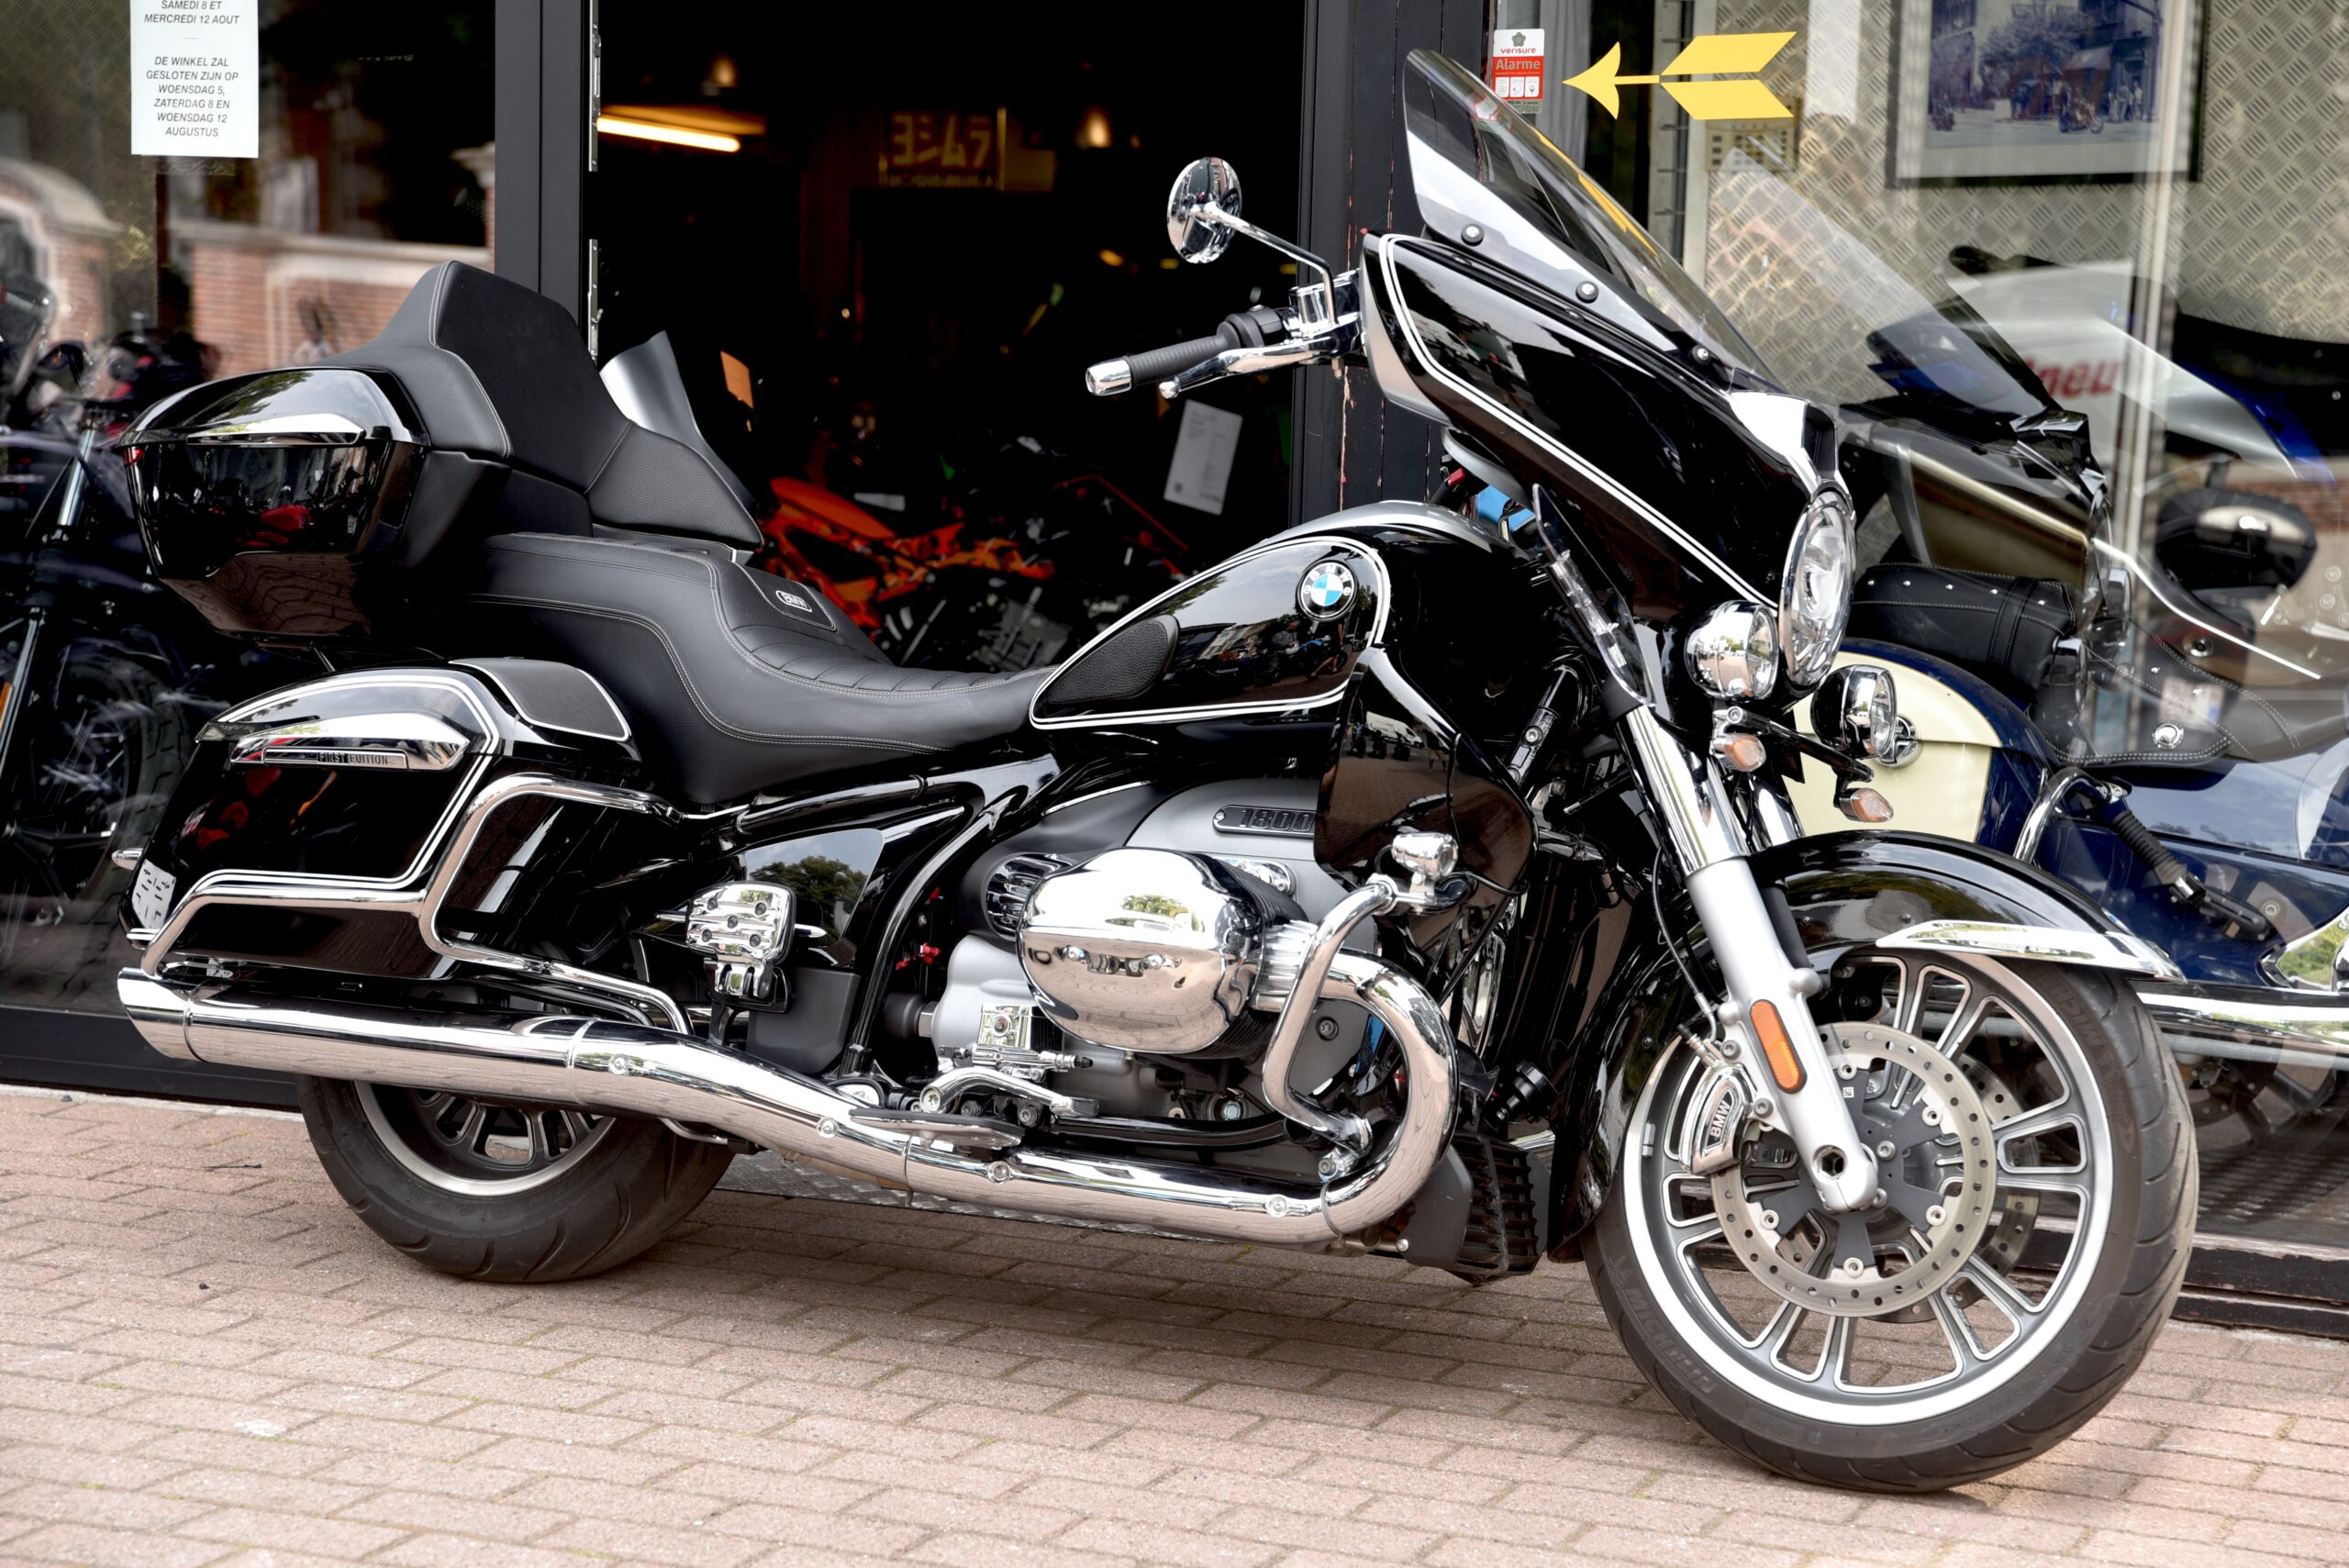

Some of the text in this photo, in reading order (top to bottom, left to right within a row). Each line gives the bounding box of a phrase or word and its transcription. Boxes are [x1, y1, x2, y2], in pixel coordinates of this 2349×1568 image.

[161, 0, 223, 10] SAMEDI 8 ET
[144, 14, 240, 25] MERCREDI 12 AOUT
[154, 56, 229, 67] DE WINKEL ZAL
[1496, 59, 1542, 71] Alarme
[146, 71, 239, 82] GESLOTEN ZIJN OP
[158, 84, 226, 96] WOENSDAG 5,
[154, 98, 230, 109] ZATERDAG 8 EN
[157, 112, 228, 123] WOENSDAG 12
[165, 127, 219, 137] AUGUSTUS
[892, 113, 991, 168] ヨシムラ
[2025, 358, 2121, 399] neu
[780, 592, 808, 609] BMW
[319, 751, 389, 765] FIRST EDITION
[1239, 807, 1315, 832] 1800
[1710, 1099, 1731, 1138] BMW
[1621, 1288, 1719, 1395] MICHELIN
